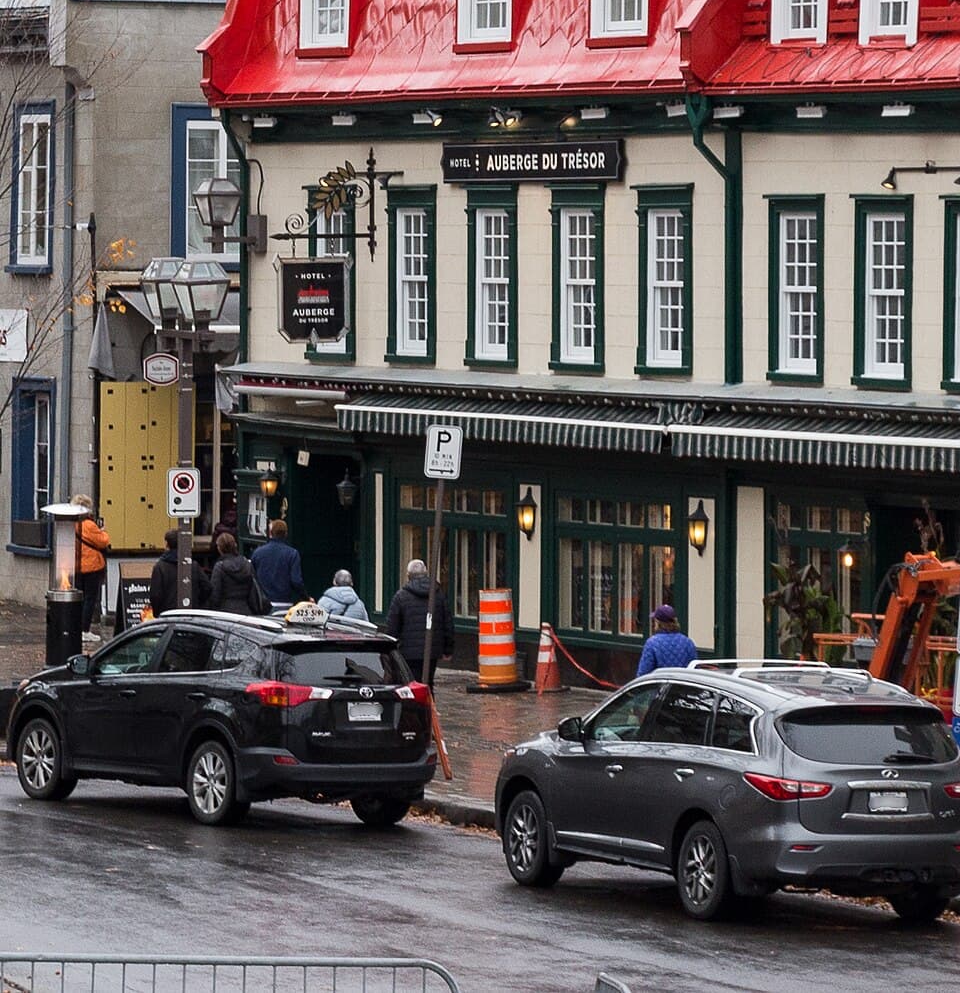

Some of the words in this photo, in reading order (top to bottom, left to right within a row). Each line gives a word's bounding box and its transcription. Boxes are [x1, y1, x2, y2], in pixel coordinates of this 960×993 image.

[450, 159, 471, 167] HOTEL
[486, 155, 539, 171] AUBERGE
[542, 153, 558, 170] DU
[561, 148, 605, 169] TRÉSOR
[293, 308, 335, 316] AUBERGE
[437, 431, 451, 452] P
